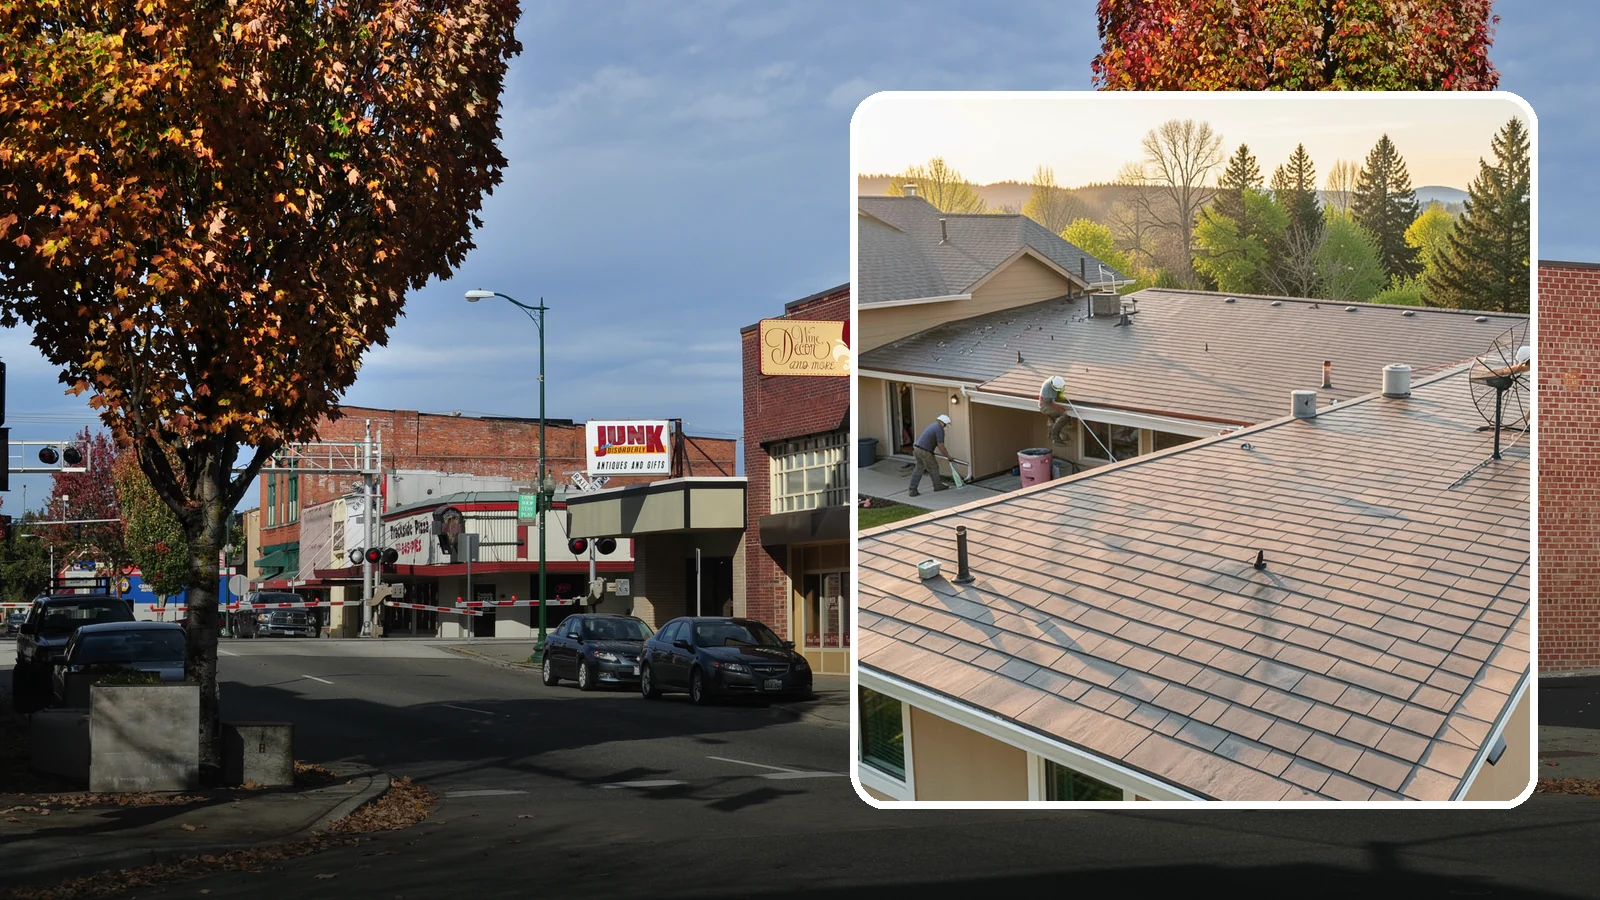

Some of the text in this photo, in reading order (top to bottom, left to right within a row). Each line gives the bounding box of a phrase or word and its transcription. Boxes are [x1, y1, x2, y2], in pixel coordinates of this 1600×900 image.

[596, 425, 665, 457] JUNK
[607, 446, 646, 454] DISORDERLY
[596, 460, 665, 470] ANTIQUES AND GIFTS
[390, 519, 429, 540] Trackside Pizza
